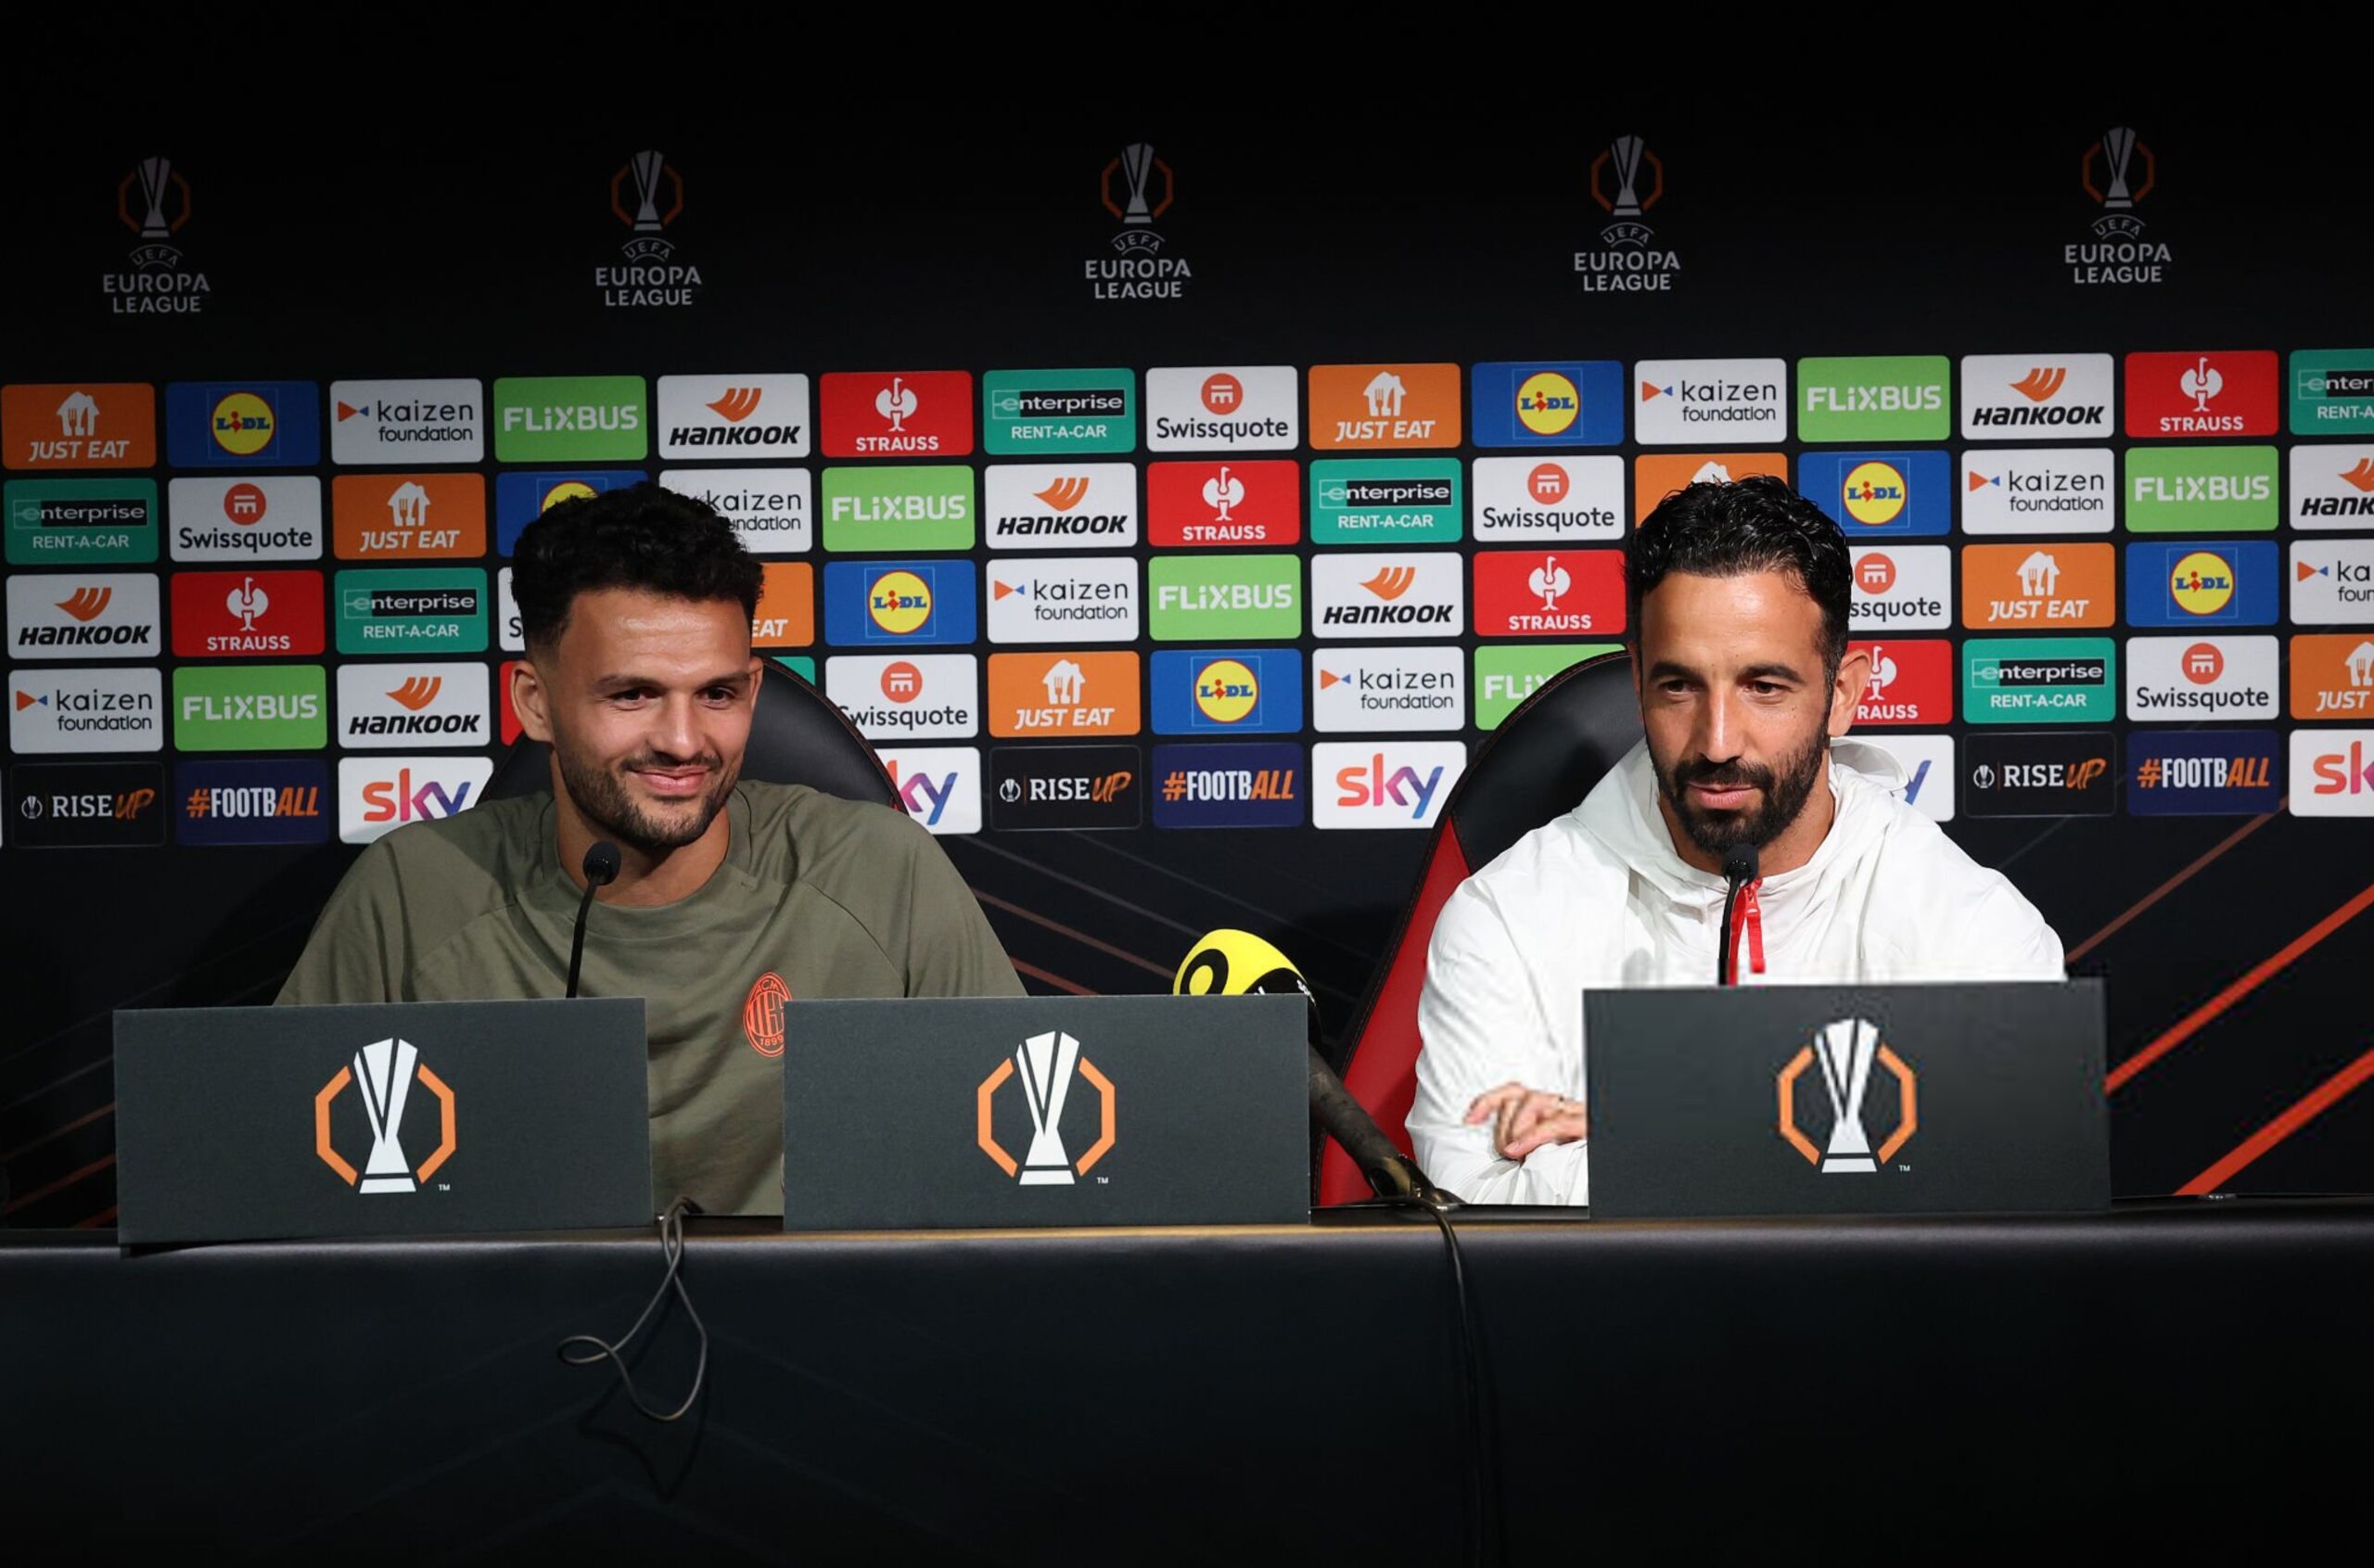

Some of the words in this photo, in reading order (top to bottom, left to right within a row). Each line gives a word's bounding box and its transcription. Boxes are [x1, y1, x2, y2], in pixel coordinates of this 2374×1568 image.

[1603, 226, 1649, 244] UEFA
[2095, 219, 2140, 236] UEFA
[624, 242, 670, 259] UEFA
[1115, 235, 1159, 251] UEFA
[132, 249, 177, 265] UEFA
[1575, 251, 1681, 272] EUROPA
[2064, 243, 2173, 263] EUROPA
[595, 266, 702, 286] EUROPA
[1085, 259, 1192, 279] EUROPA
[2074, 266, 2163, 284] LEAGUE
[103, 274, 211, 293] EUROPA
[1095, 281, 1182, 300] LEAGUE
[1584, 274, 1671, 291] LEAGUE
[113, 296, 201, 313] LEAGUE
[606, 289, 693, 306] LEAGUE
[1681, 380, 1777, 402] kaizen
[2305, 376, 2374, 391] enter
[377, 400, 474, 423] kaizen
[1001, 394, 1123, 414] enterprise
[2317, 405, 2374, 419] RENT-A
[1683, 406, 1776, 422] foundation
[378, 425, 474, 442] foundation
[1011, 425, 1107, 440] RENT-A-CAR
[1156, 417, 1288, 443] Swissquote
[1335, 421, 1391, 442] JUST
[1394, 420, 1436, 439] EAT
[2160, 416, 2243, 432] STRAUSS
[29, 442, 86, 462] JUST
[88, 440, 129, 459] EAT
[856, 435, 938, 452] STRAUSS
[2009, 469, 2104, 491] kaizen
[707, 490, 801, 511] kaizen
[1327, 484, 1450, 503] enterprise
[21, 504, 146, 522] enterprise
[2010, 495, 2103, 512] foundation
[1337, 514, 1434, 529] RENT-A-CAR
[1483, 507, 1615, 532] Swissquote
[32, 534, 129, 549] RENT-A-CAR
[179, 528, 313, 553] Swissquote
[360, 532, 416, 553] JUST
[418, 530, 460, 549] EAT
[1182, 525, 1266, 541] STRAUSS
[1034, 579, 1129, 601] kaizen
[351, 593, 475, 611] enterprise
[1034, 603, 1128, 620] foundation
[1850, 597, 1941, 622] ssquote
[1988, 601, 2043, 622] JUST
[2047, 599, 2089, 618] EAT
[363, 623, 459, 639] RENT-A-CAR
[1508, 615, 1591, 630] STRAUSS
[207, 635, 290, 651] STRAUSS
[1360, 668, 1455, 691] kaizen
[1979, 663, 2103, 682] enterprise
[56, 689, 153, 712] kaizen
[1361, 693, 1454, 710] foundation
[1990, 694, 2087, 708] RENT-A-CAR
[2137, 686, 2269, 712] Swissquote
[2317, 691, 2369, 711] JUST
[1015, 708, 1070, 730] JUST
[1073, 708, 1115, 727] EAT
[1857, 705, 1918, 720] RAUSS
[57, 713, 152, 732] foundation
[2138, 758, 2270, 788] #FOOTBALL
[2313, 741, 2374, 795] sk
[887, 760, 958, 825] ky
[1162, 770, 1295, 801] #FOOTBALL
[1336, 752, 1444, 819] sky
[186, 786, 319, 818] #FOOTBALL
